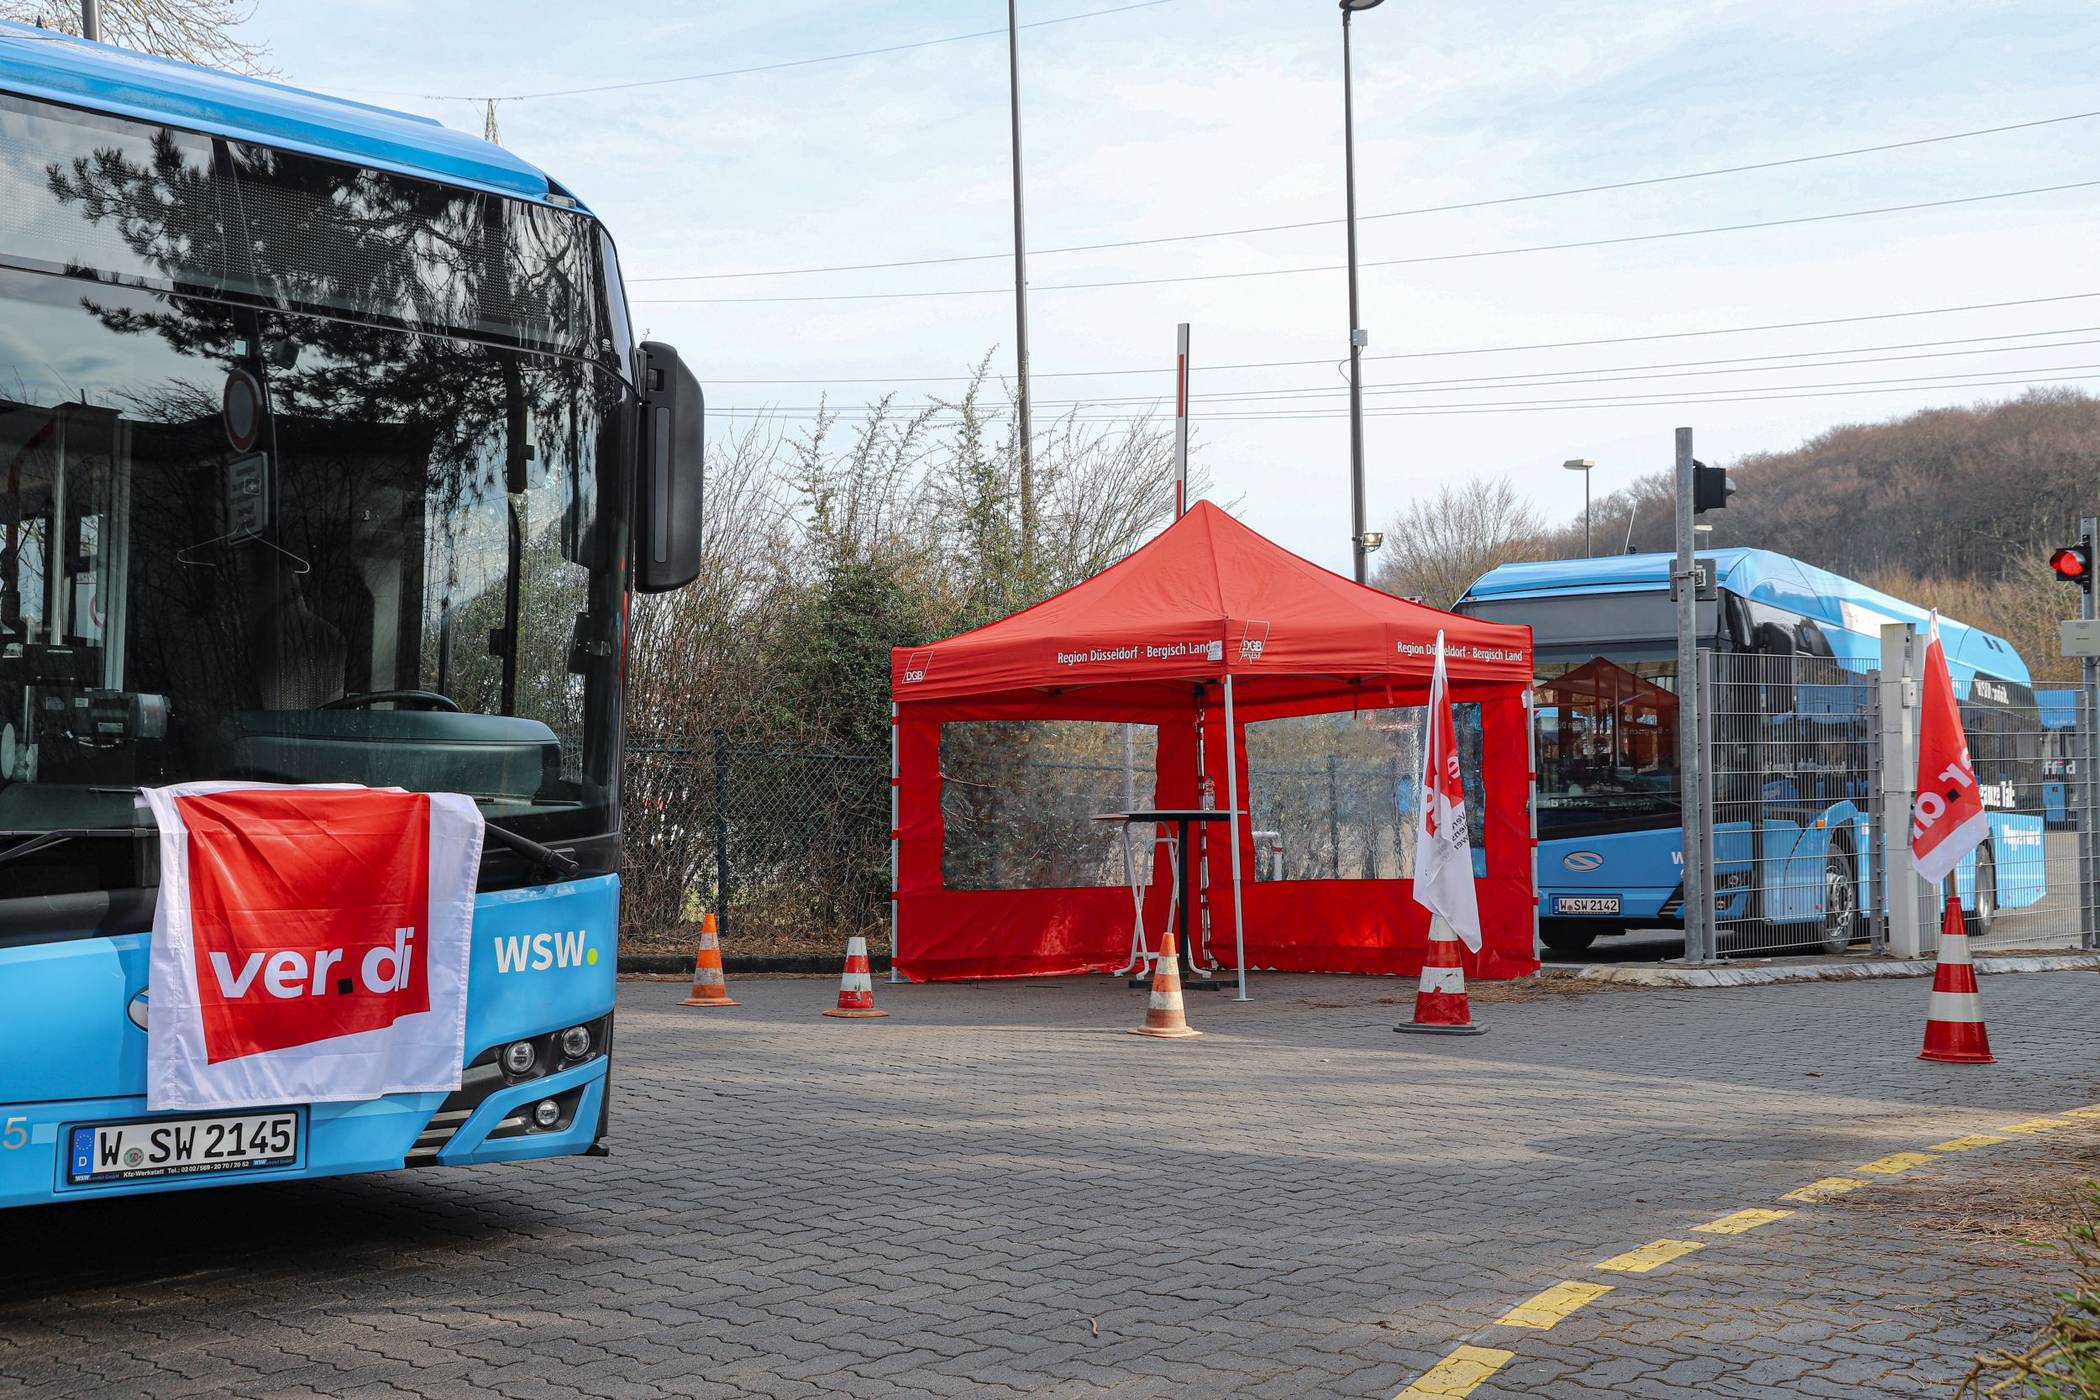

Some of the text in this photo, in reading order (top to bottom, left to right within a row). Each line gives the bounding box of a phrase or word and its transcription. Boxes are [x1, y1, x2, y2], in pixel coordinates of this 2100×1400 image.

[1057, 651, 1087, 665] Region
[1090, 646, 1138, 661] Düsseldorf
[1146, 643, 1186, 660] Bergisch
[1397, 641, 1425, 656] Region
[1426, 643, 1466, 658] Düeldorf
[1472, 647, 1504, 662] Bergisch
[1505, 650, 1523, 661] Land
[906, 671, 923, 681] DGB
[1560, 900, 1617, 911] W SW 2142
[208, 927, 415, 998] ver.di
[100, 1119, 291, 1166] W SW 2145
[78, 1156, 87, 1167] D
[123, 1169, 165, 1178] Kfz-Werkstatt
